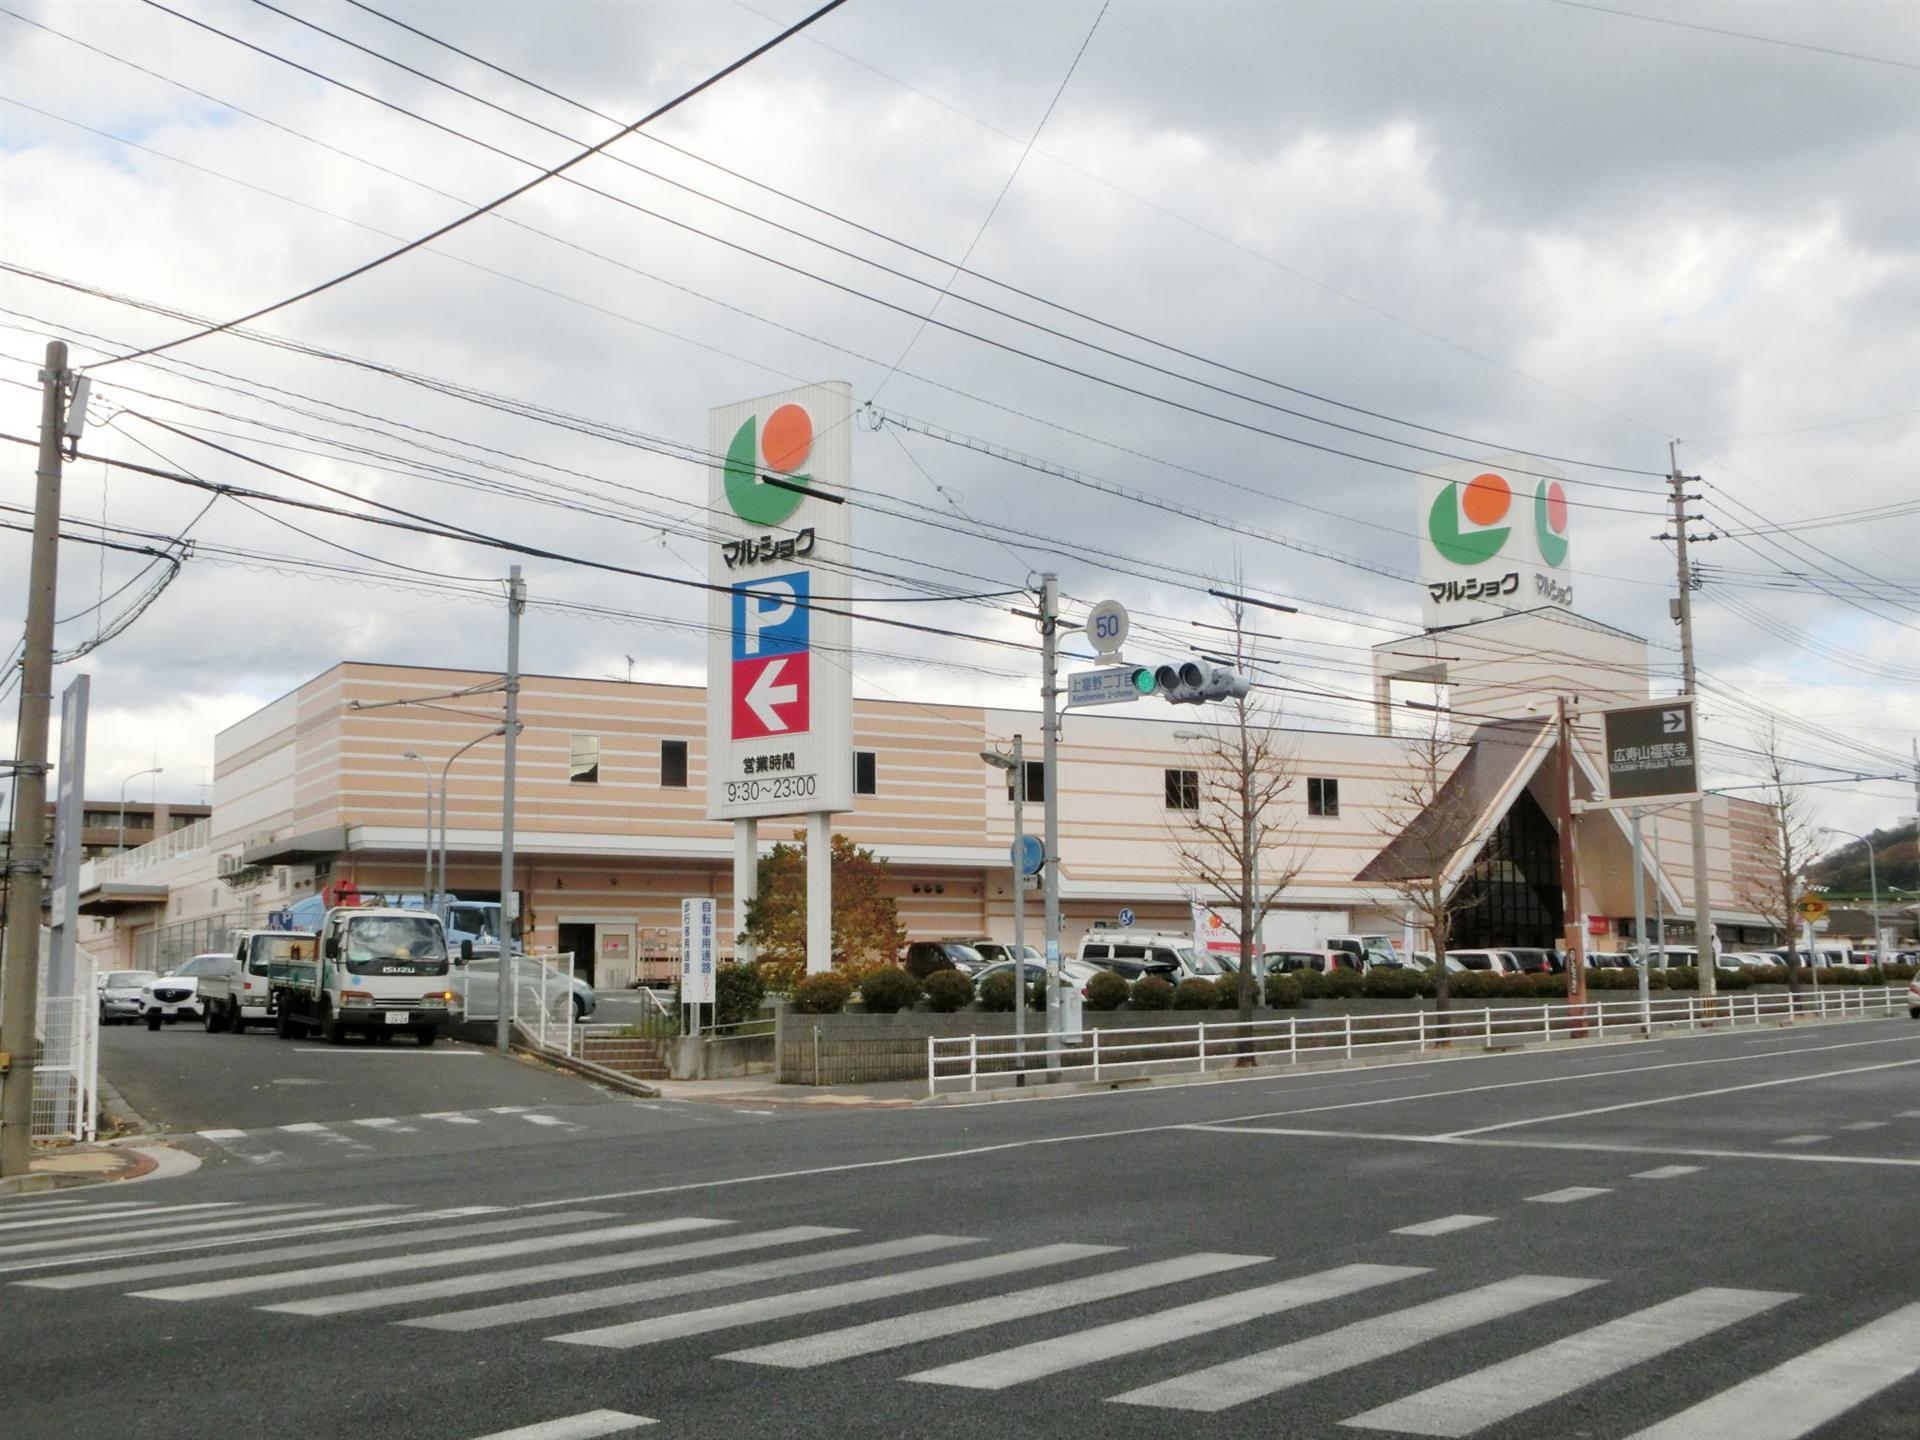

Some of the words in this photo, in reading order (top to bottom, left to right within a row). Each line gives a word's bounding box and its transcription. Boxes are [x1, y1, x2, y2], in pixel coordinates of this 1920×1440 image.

[722, 527, 815, 568] マルショク
[1428, 572, 1519, 604] マルショク
[745, 580, 796, 655] P
[1096, 615, 1118, 638] 50
[743, 752, 795, 773] 営業時間
[702, 901, 711, 973] 自転車用通路
